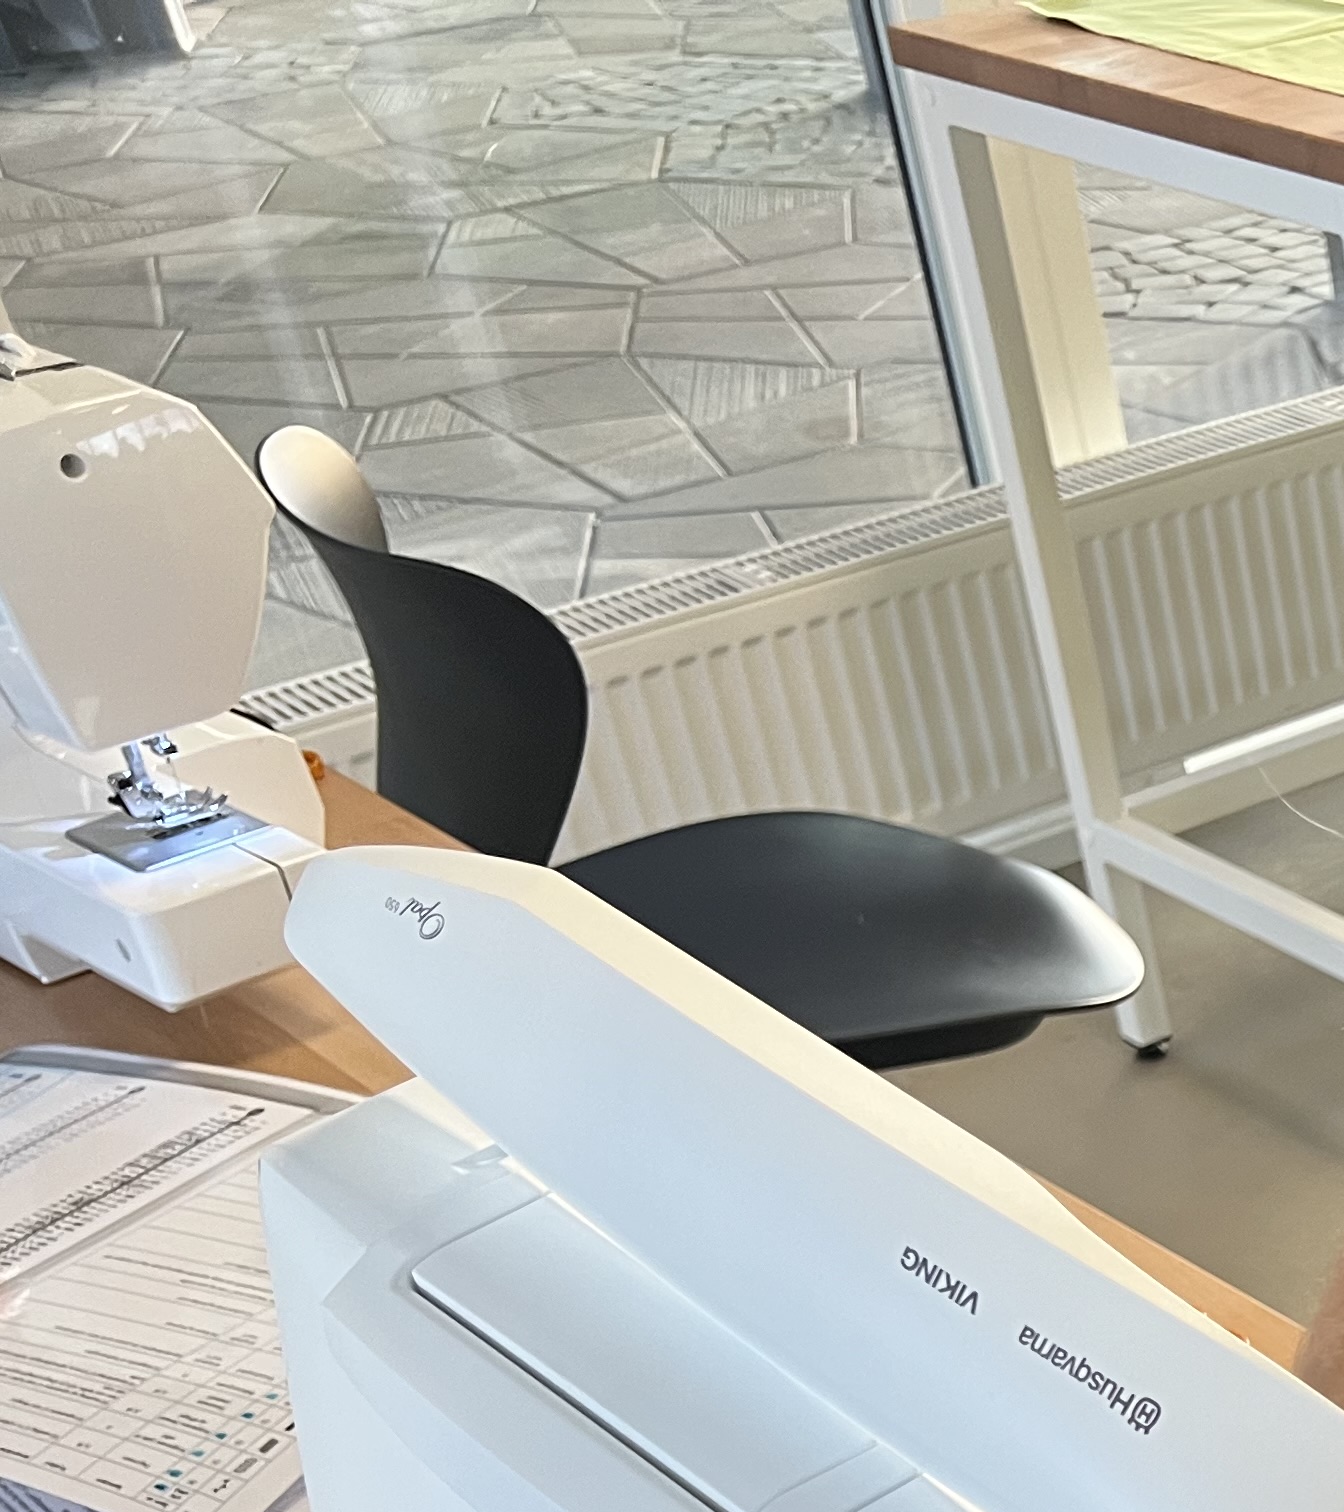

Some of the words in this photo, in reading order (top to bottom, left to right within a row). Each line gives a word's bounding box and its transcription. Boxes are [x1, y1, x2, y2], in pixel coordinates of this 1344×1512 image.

[384, 896, 401, 913] 650
[399, 897, 445, 940] Opal
[900, 1246, 979, 1315] VIKING
[1018, 1325, 1136, 1416] Husqvarna
